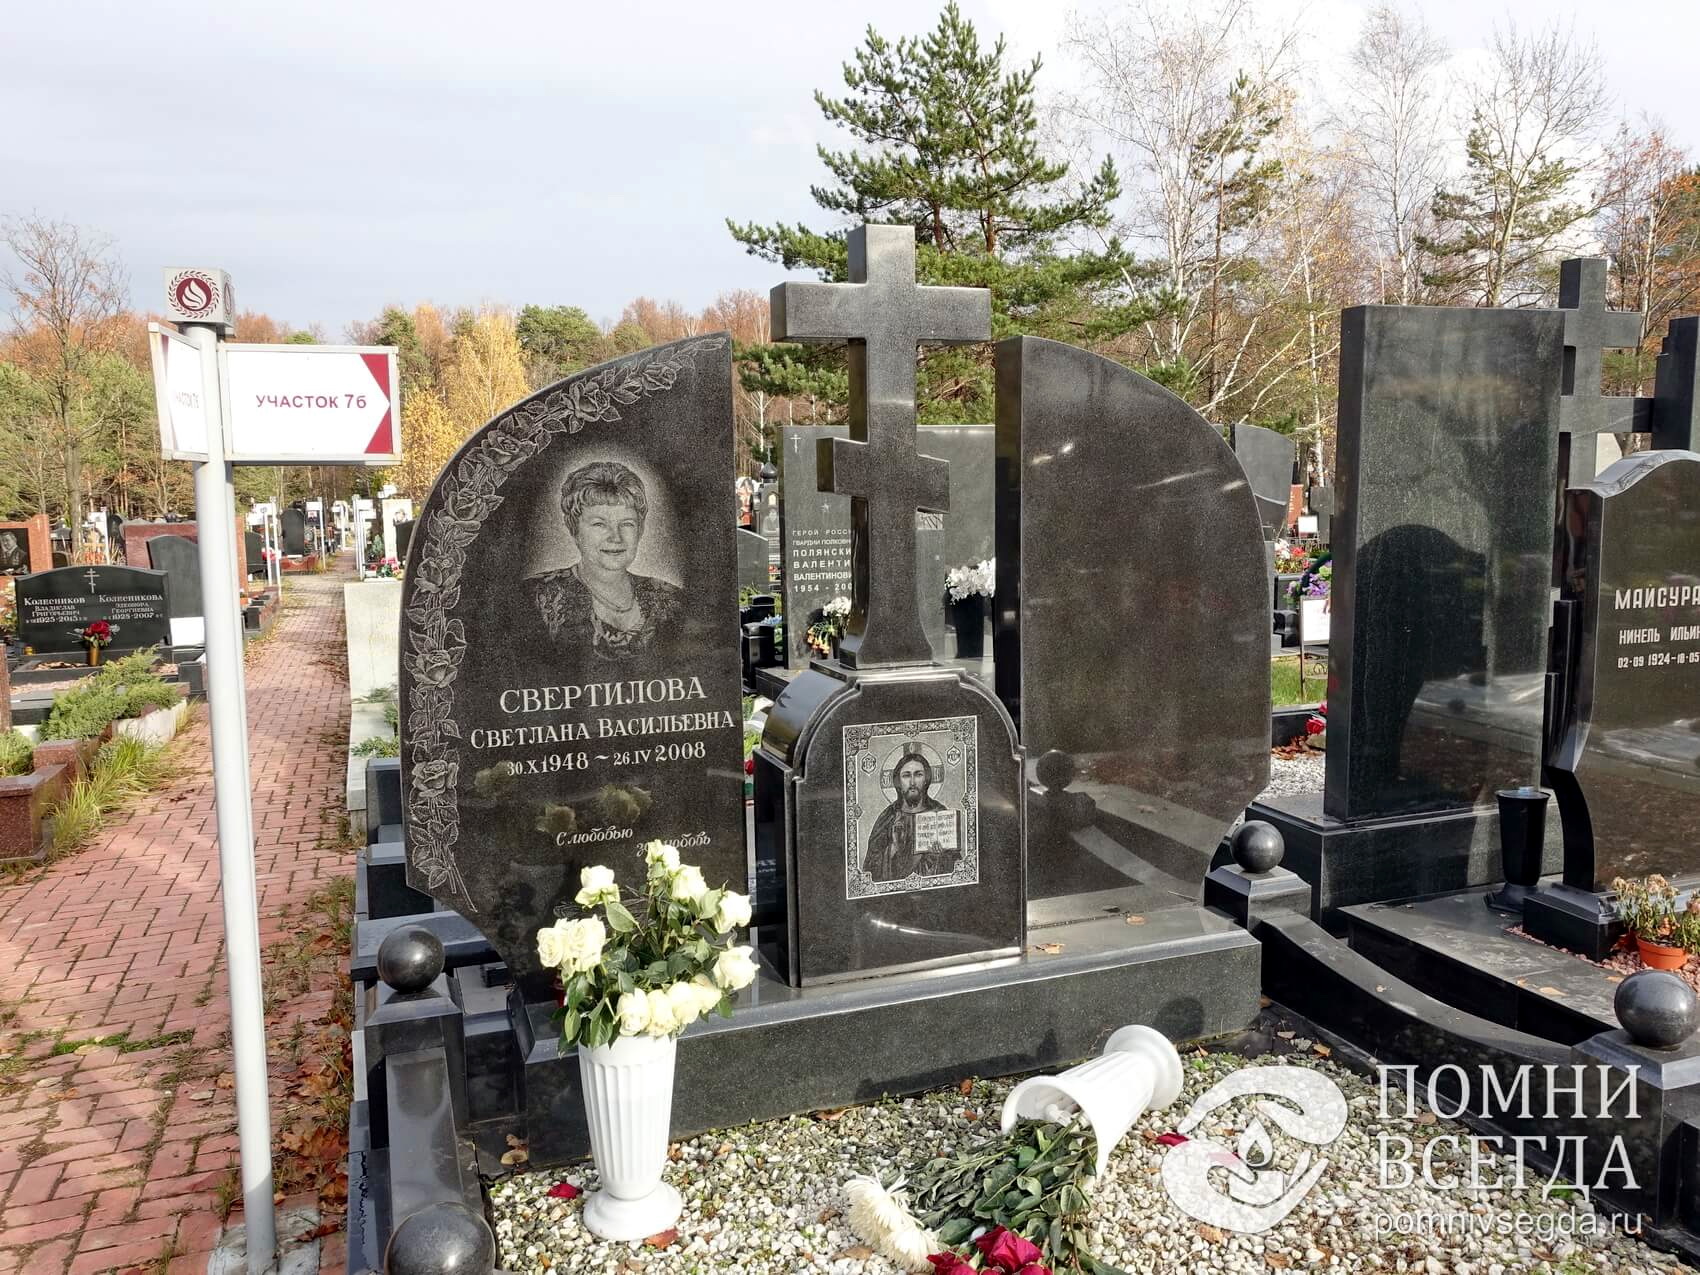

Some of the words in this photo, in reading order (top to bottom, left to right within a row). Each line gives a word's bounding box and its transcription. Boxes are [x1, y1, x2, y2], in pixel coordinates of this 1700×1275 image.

[256, 394, 339, 409] УЧАСТОК
[794, 583, 820, 593] 1954
[1619, 627, 1661, 645] НИНЕЛЬ
[499, 676, 708, 714] СВЕРТИЛОВА
[470, 722, 592, 750] СВЕТЛАНА
[598, 710, 736, 739] ВАСИЛЬЕВНА
